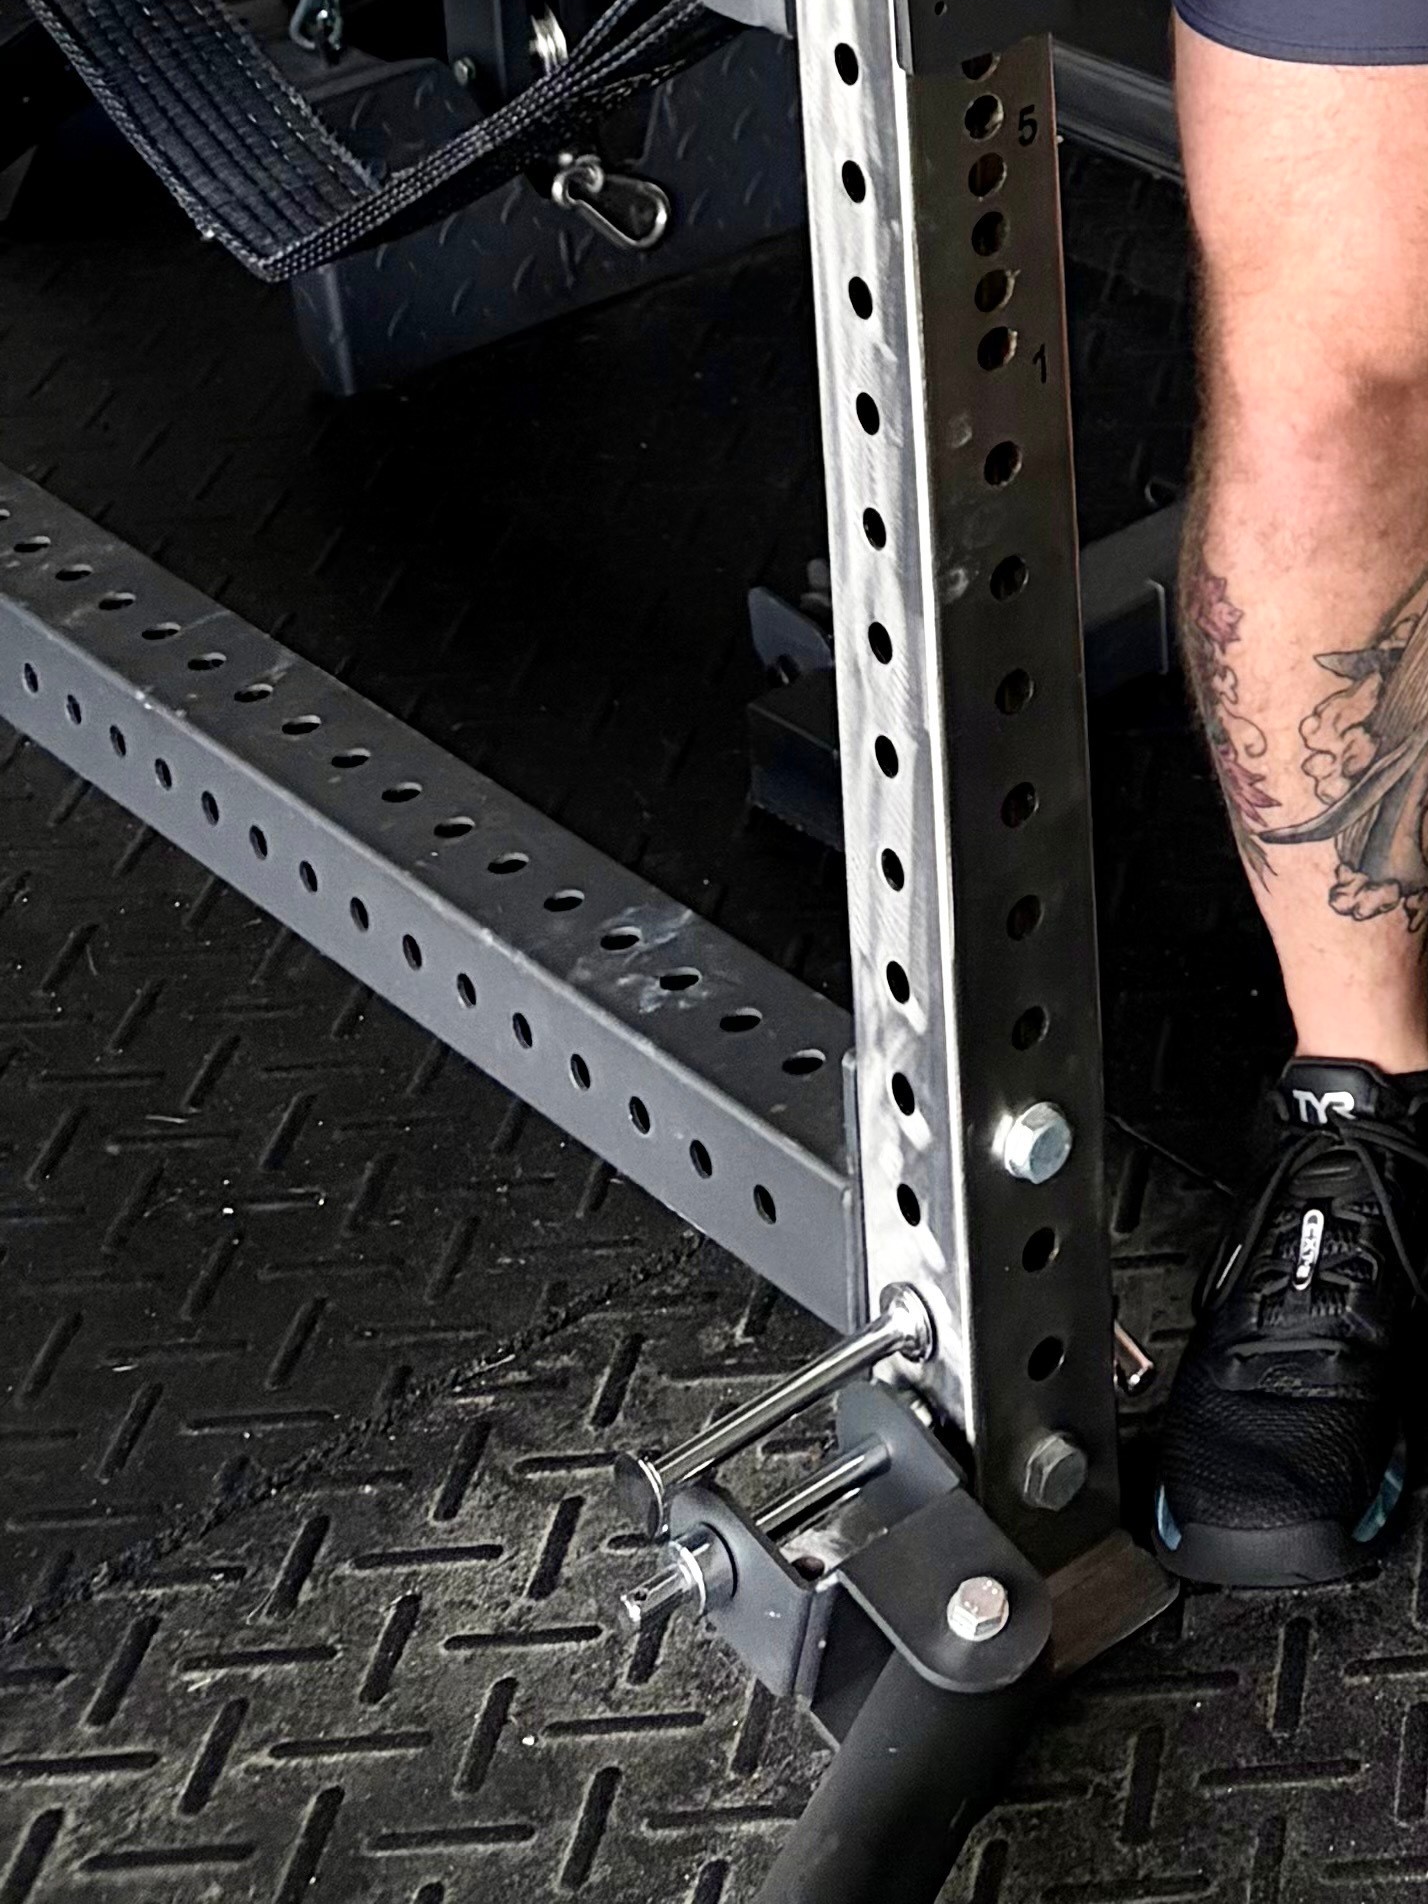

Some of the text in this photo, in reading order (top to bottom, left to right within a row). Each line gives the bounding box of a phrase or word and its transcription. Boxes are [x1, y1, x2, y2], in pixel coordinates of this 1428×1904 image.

[1018, 104, 1038, 146] 5
[1033, 344, 1047, 383] 1
[1292, 1089, 1357, 1124] TYR
